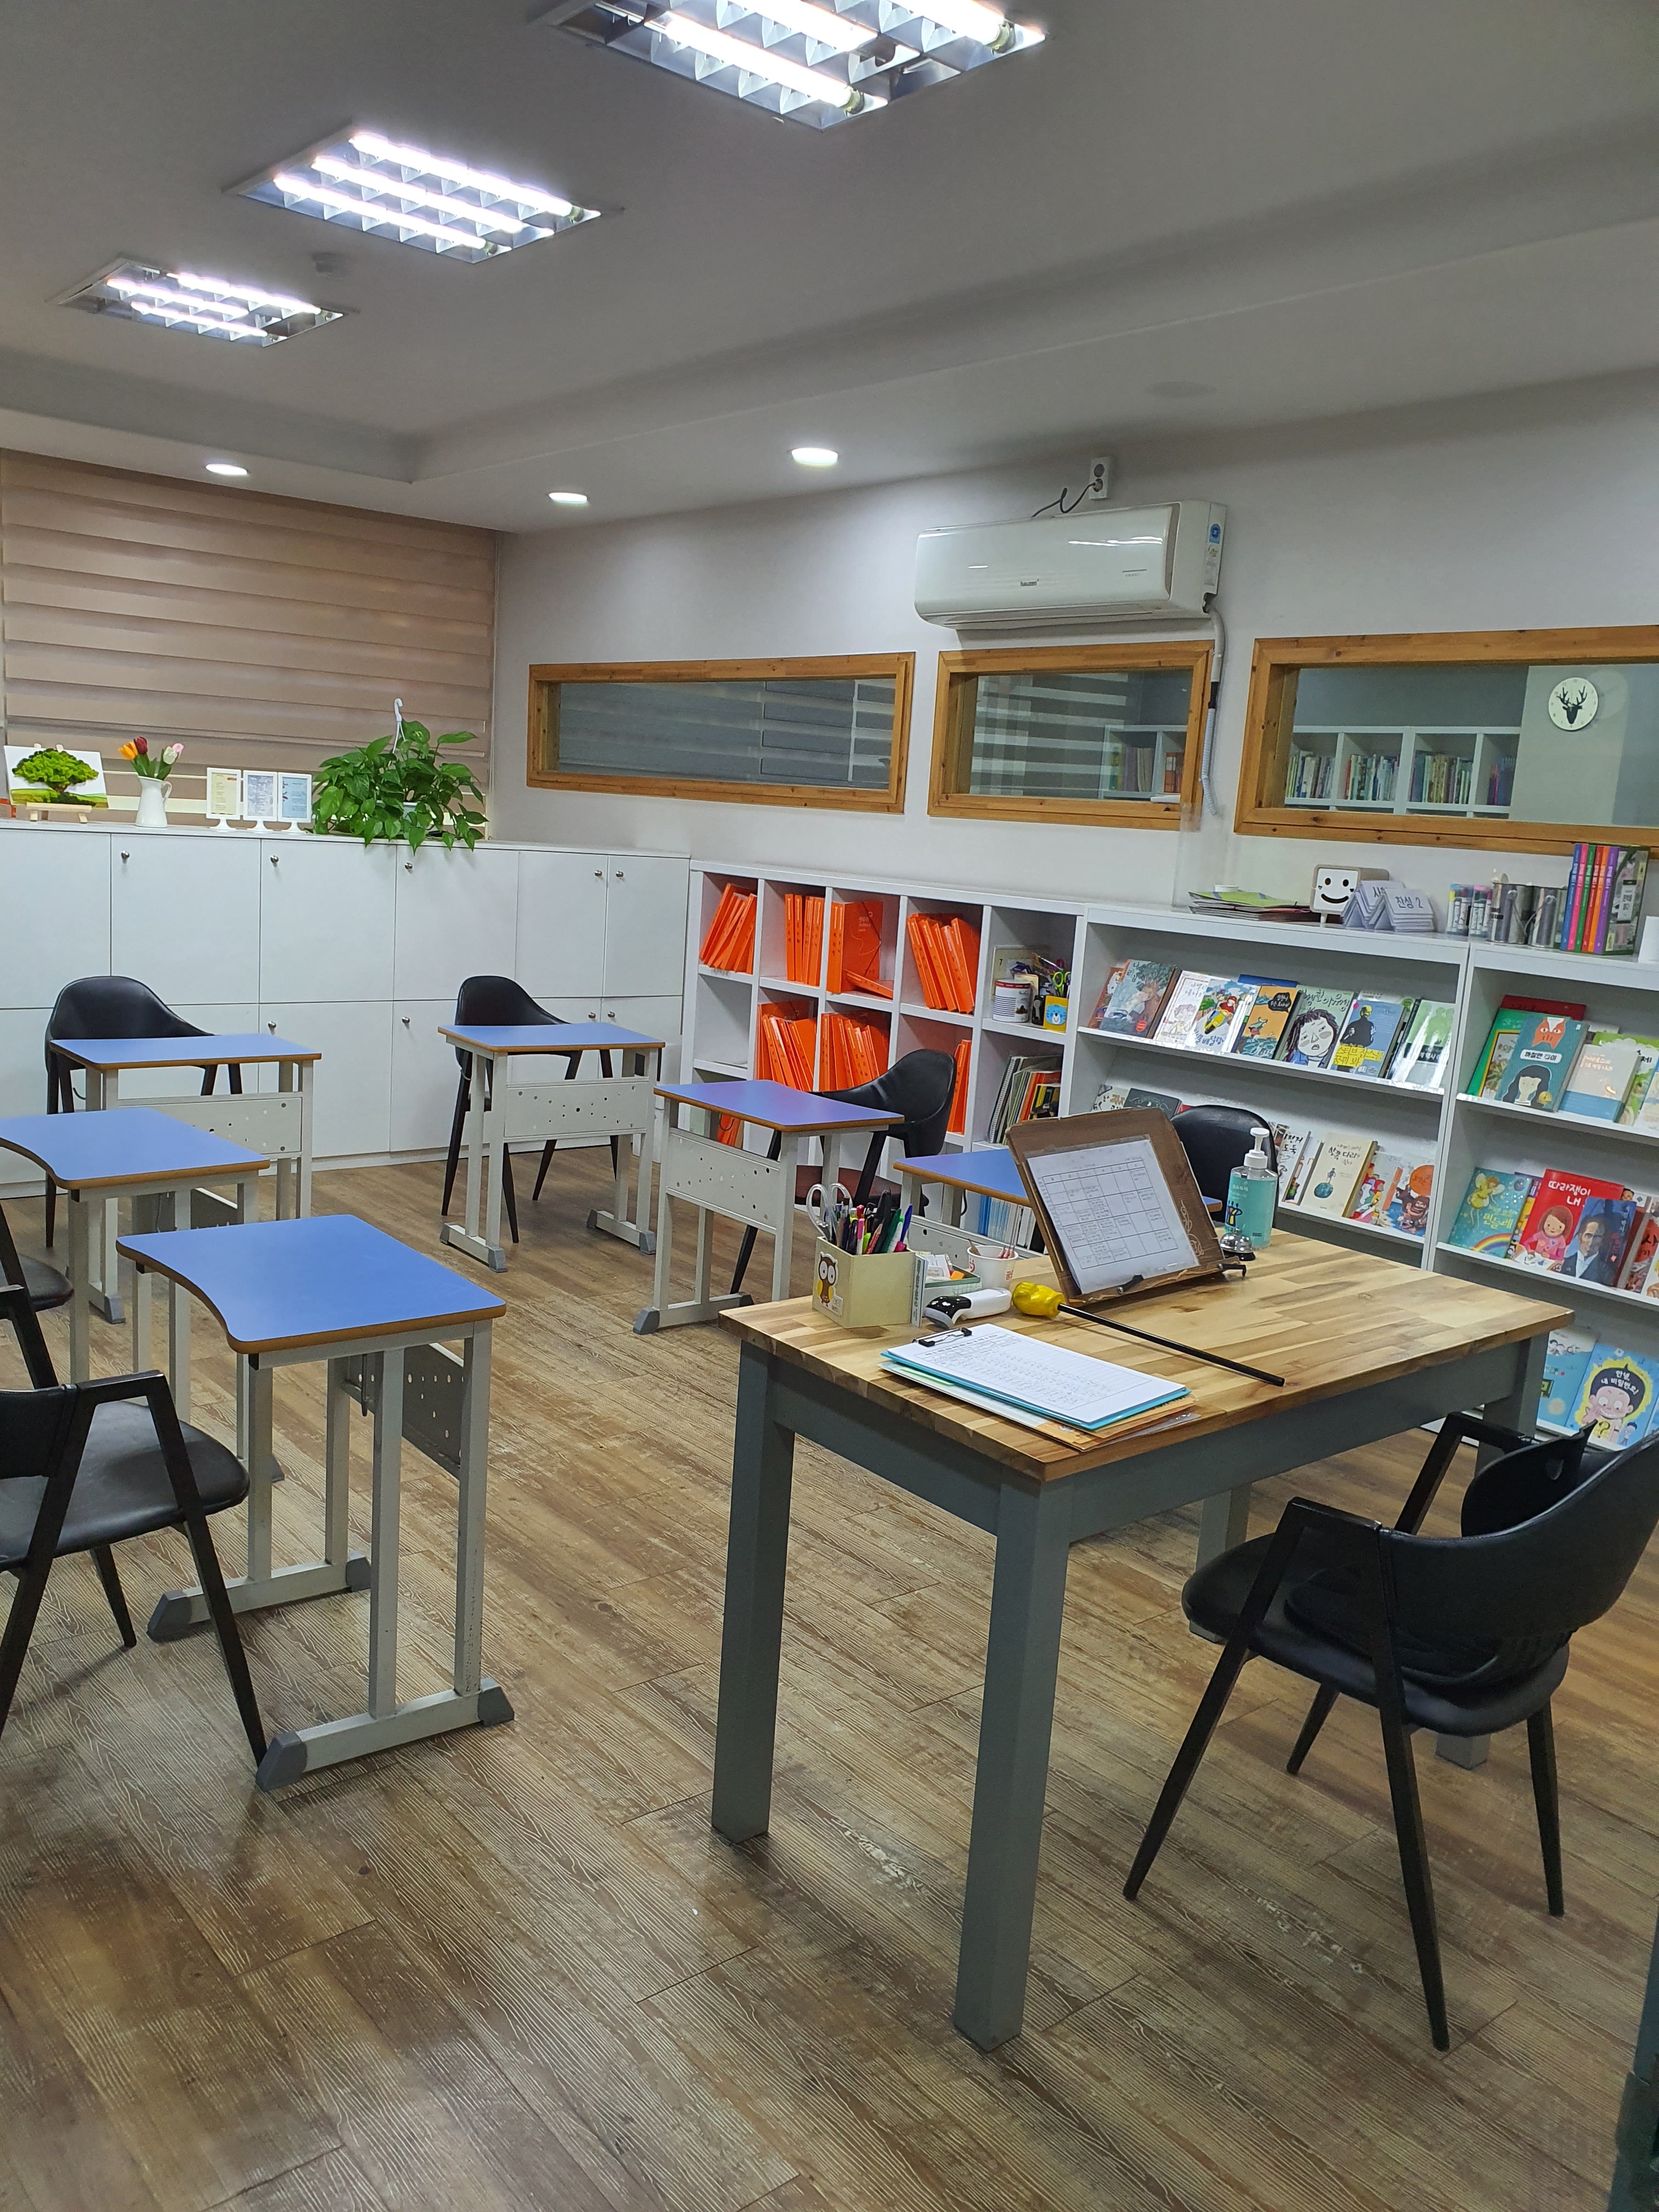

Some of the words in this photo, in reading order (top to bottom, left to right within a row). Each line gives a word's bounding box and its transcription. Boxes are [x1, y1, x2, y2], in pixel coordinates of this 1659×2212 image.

[1395, 896, 1414, 909] 찬성
[1415, 897, 1423, 908] 2
[1336, 1045, 1358, 1056] 스티브
[1282, 1144, 1297, 1155] 도둑
[1548, 1180, 1591, 1196] 따라쟁이
[1566, 1195, 1582, 1206] 내
[1482, 1212, 1514, 1230] 민들레
[1615, 1370, 1630, 1381] 안녕,
